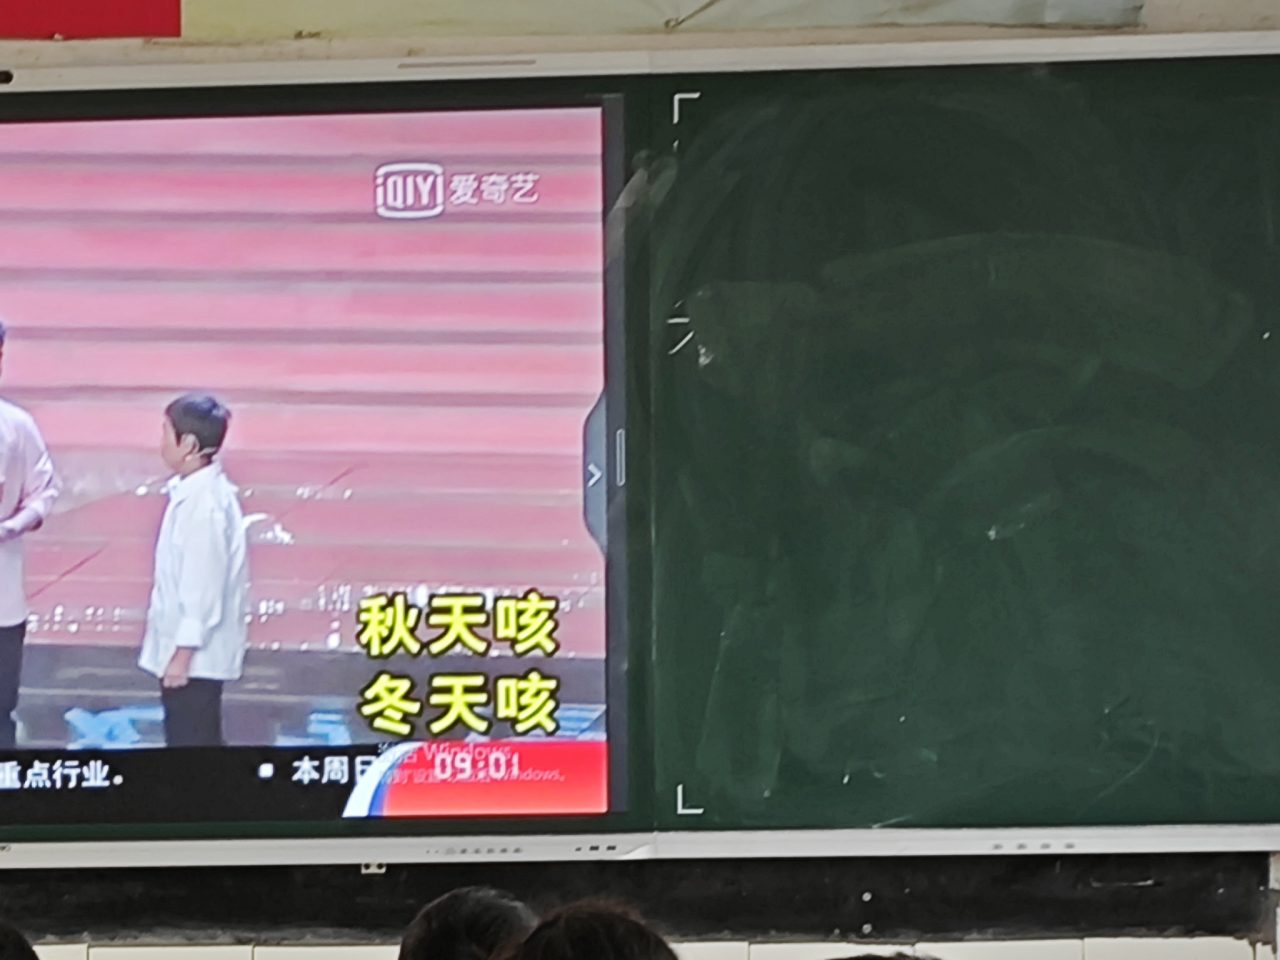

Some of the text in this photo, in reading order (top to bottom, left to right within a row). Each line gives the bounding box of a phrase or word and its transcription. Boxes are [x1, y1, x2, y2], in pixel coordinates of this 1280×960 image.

[449, 172, 540, 205] 爱奇艺
[358, 589, 558, 657] 秋天咳
[360, 669, 558, 736] 冬天咳
[434, 751, 519, 781] 09:01
